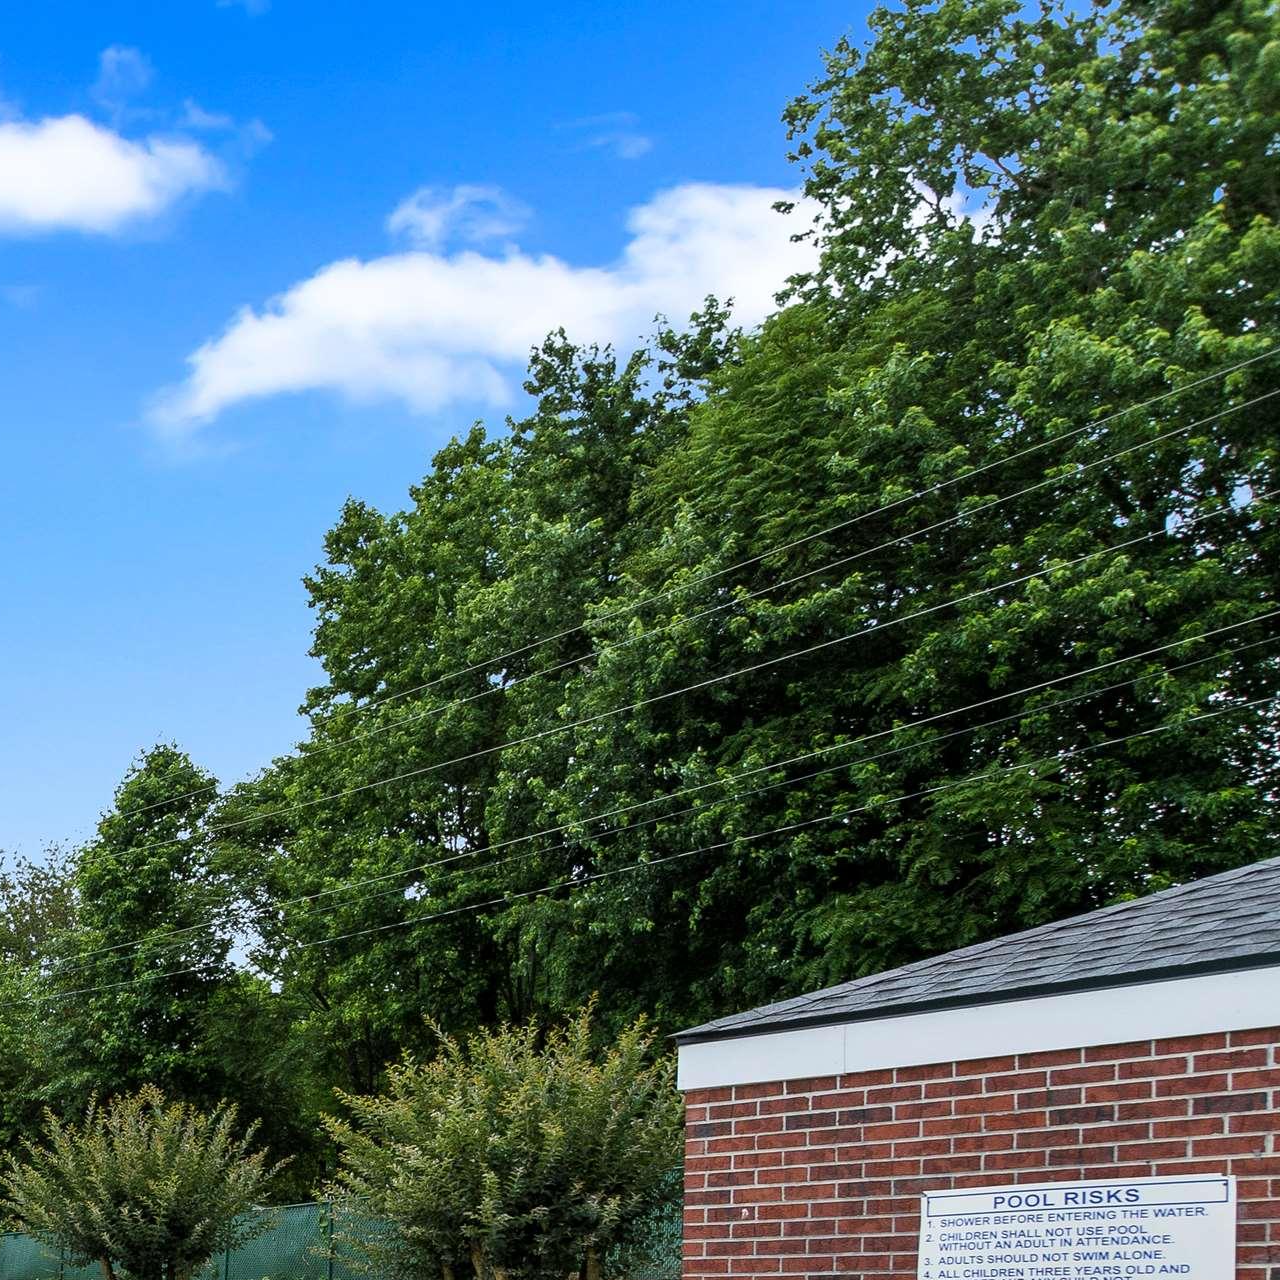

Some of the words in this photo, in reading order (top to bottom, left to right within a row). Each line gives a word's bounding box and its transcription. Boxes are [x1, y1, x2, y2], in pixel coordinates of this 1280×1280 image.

[994, 1193, 1054, 1208] POOL
[1064, 1188, 1139, 1205] RISKS
[927, 1220, 934, 1228] 1.
[940, 1216, 990, 1227] SHOWER
[993, 1213, 1043, 1224] BEFORE
[1048, 1210, 1116, 1222] ENTERING
[1120, 1208, 1148, 1219] THE
[925, 1234, 934, 1242] 2.
[940, 1231, 997, 1241] CHILDREN
[1001, 1229, 1041, 1238] SHALL
[1045, 1227, 1072, 1237] NOT
[1076, 1226, 1103, 1236] USE
[1108, 1224, 1147, 1234] POOL
[939, 1241, 991, 1251] WITHOUT
[994, 1240, 1011, 1248] AN
[1014, 1238, 1056, 1248] ADULT
[1060, 1238, 1071, 1246] IN
[924, 1257, 933, 1265] 3.
[938, 1255, 983, 1264] ADULTS
[987, 1253, 1038, 1263] SHOULD
[1042, 1252, 1068, 1262] NOT
[1073, 1251, 1109, 1261] SWIM
[923, 1270, 933, 1279] 4.
[938, 1270, 959, 1278] ALL
[963, 1268, 1023, 1277] CHILDREN
[1028, 1266, 1070, 1276] THREE
[1074, 1265, 1121, 1275] YEARS
[1125, 1264, 1155, 1274] OLD
[1158, 1264, 1190, 1273] AND
